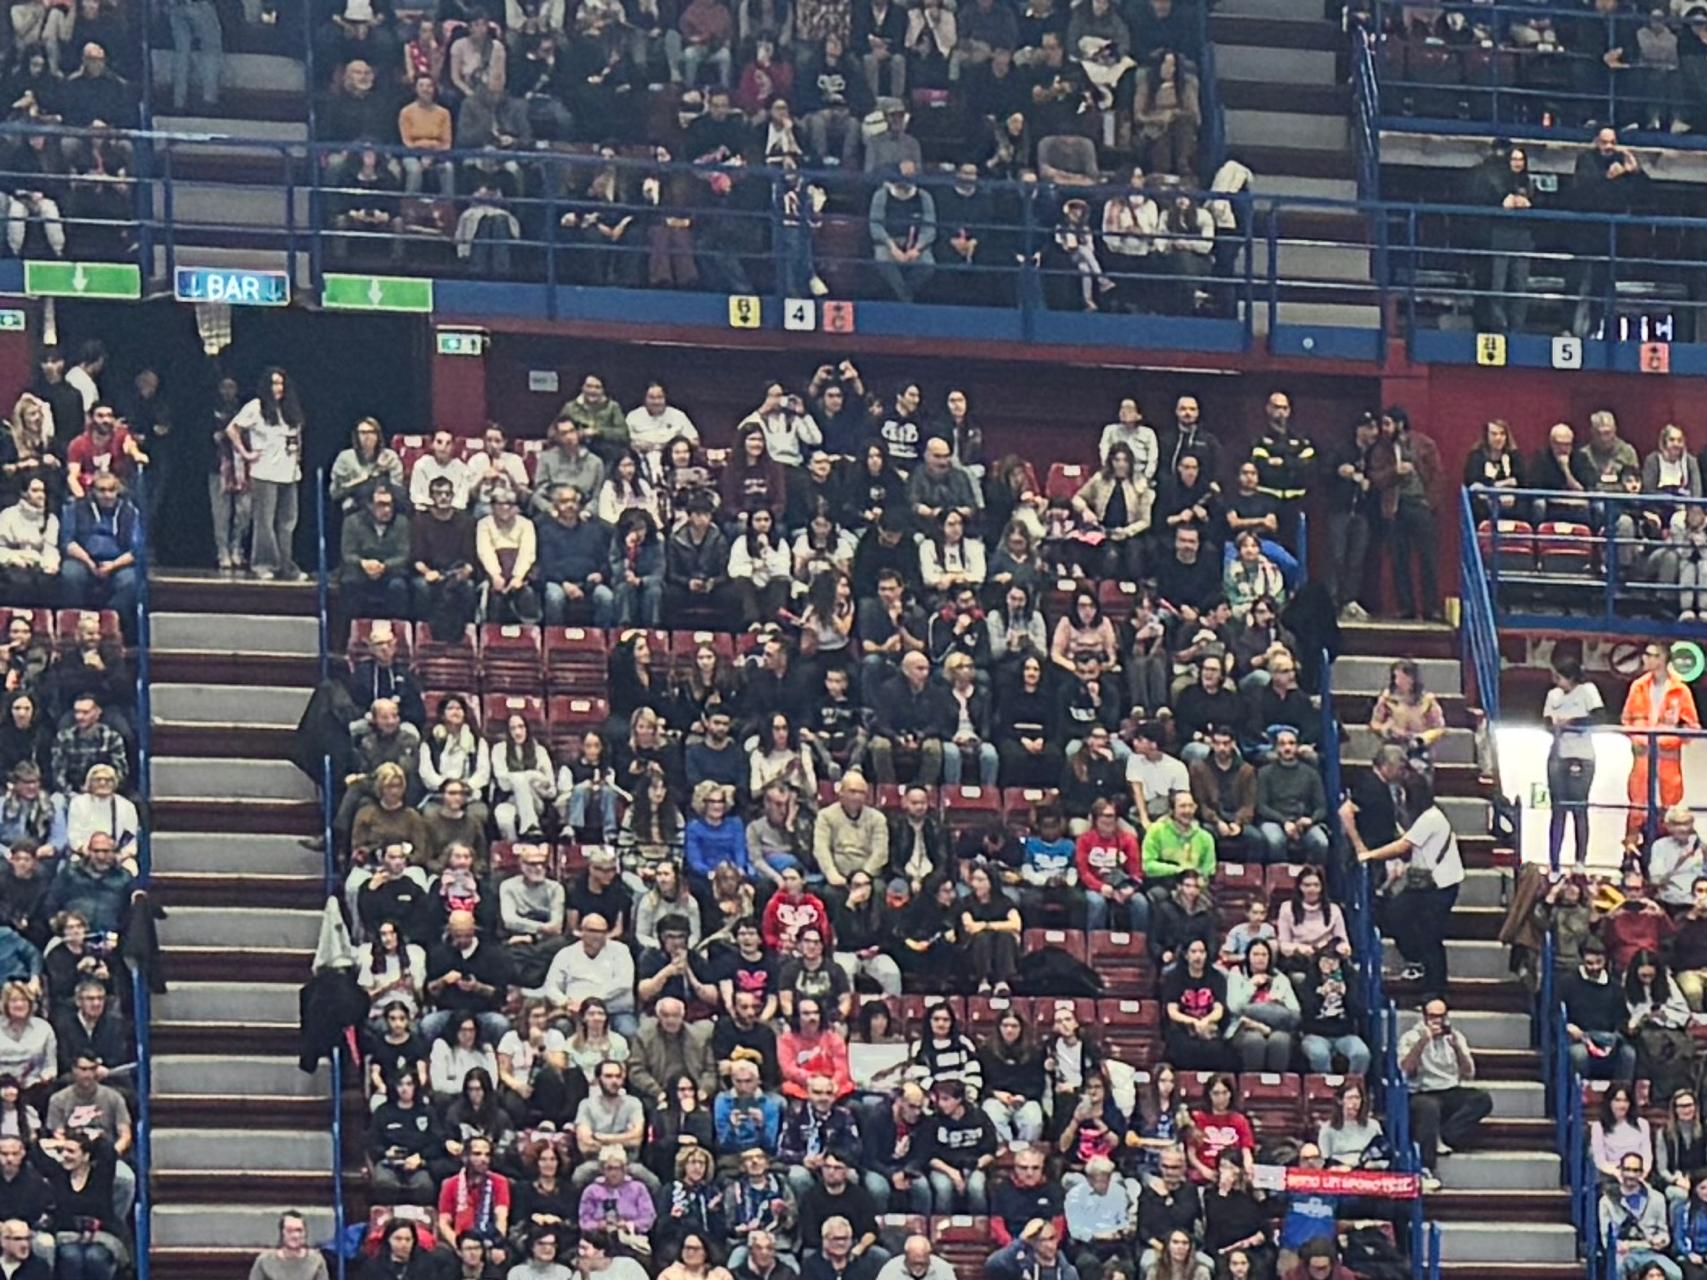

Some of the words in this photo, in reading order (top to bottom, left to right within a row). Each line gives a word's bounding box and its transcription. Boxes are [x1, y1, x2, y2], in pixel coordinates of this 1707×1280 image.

[207, 275, 261, 302] BAR
[793, 302, 806, 321] 4
[1561, 342, 1572, 361] 5
